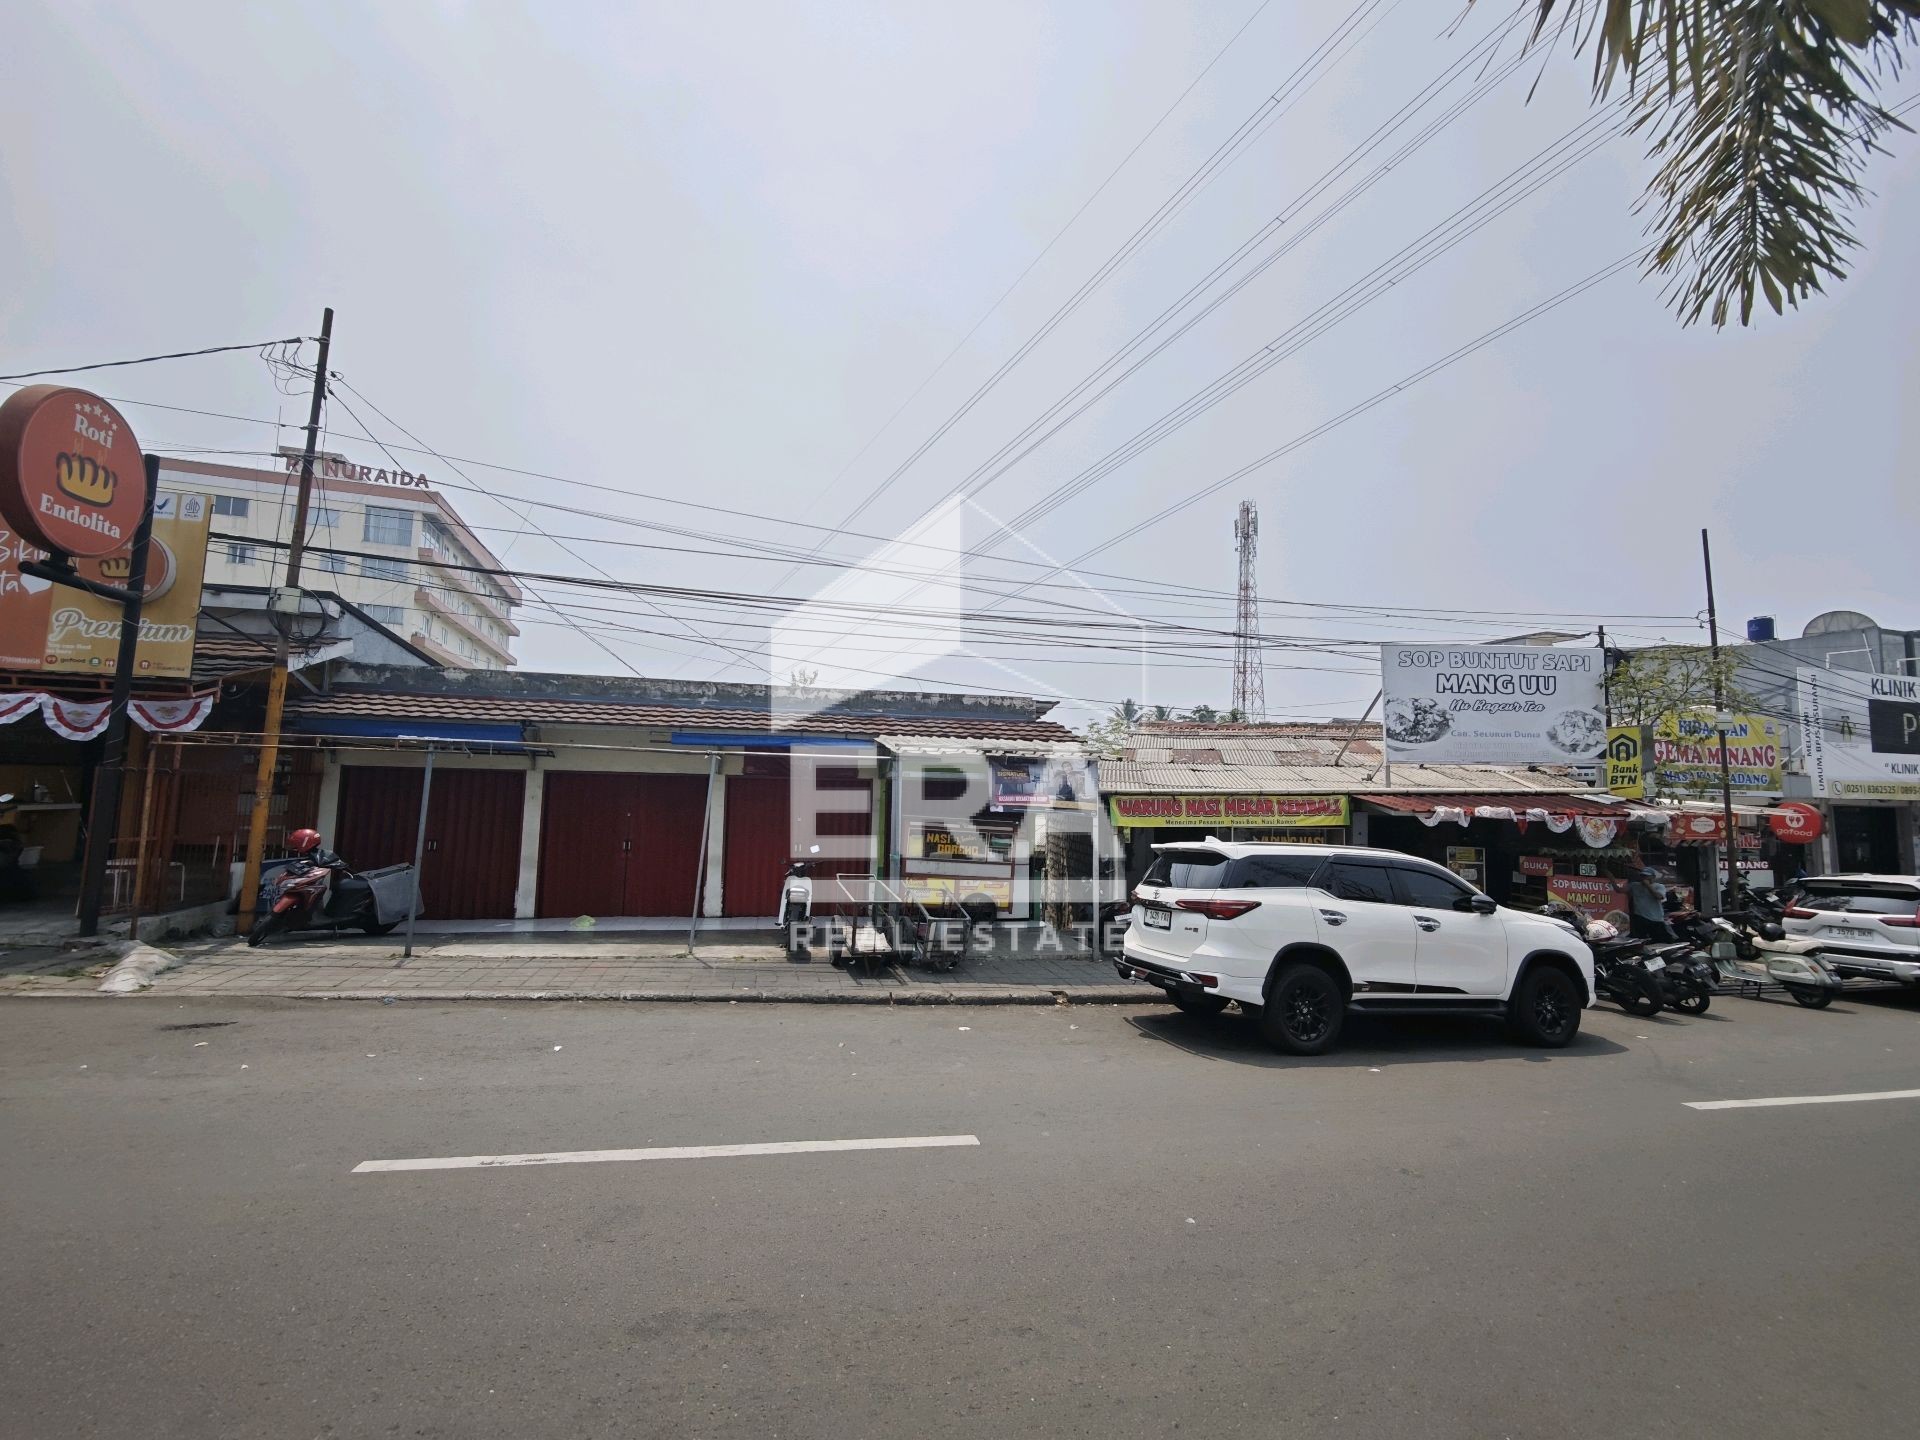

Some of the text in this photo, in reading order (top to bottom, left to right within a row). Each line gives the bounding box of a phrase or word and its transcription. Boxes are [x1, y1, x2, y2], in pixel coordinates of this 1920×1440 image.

[74, 413, 114, 449] Roti
[324, 459, 429, 489] NURAIDA
[40, 493, 120, 539] Endolita
[1399, 650, 1591, 671] SOP BUNTUT SAPI
[1436, 673, 1556, 695] MANG UU
[1872, 678, 1917, 698] KLINIK
[1449, 699, 1545, 714] Nu Bageur Tea
[1654, 740, 1776, 768] GEMA MNANG
[1612, 764, 1639, 774] Bank
[1891, 763, 1919, 775] KLINIK
[1610, 775, 1637, 785] BTN
[1730, 773, 1768, 784] ADANG
[1116, 798, 1183, 817] WARUNG
[1185, 798, 1222, 817] NASI
[1224, 798, 1275, 817] MEKAR
[927, 833, 951, 844] NASI
[1776, 827, 1813, 837] gofood
[1523, 861, 1549, 870] BUKA
[1552, 879, 1569, 889] SOP
[1571, 880, 1603, 891] BUNTUT
[1567, 892, 1611, 905] MANG UU
